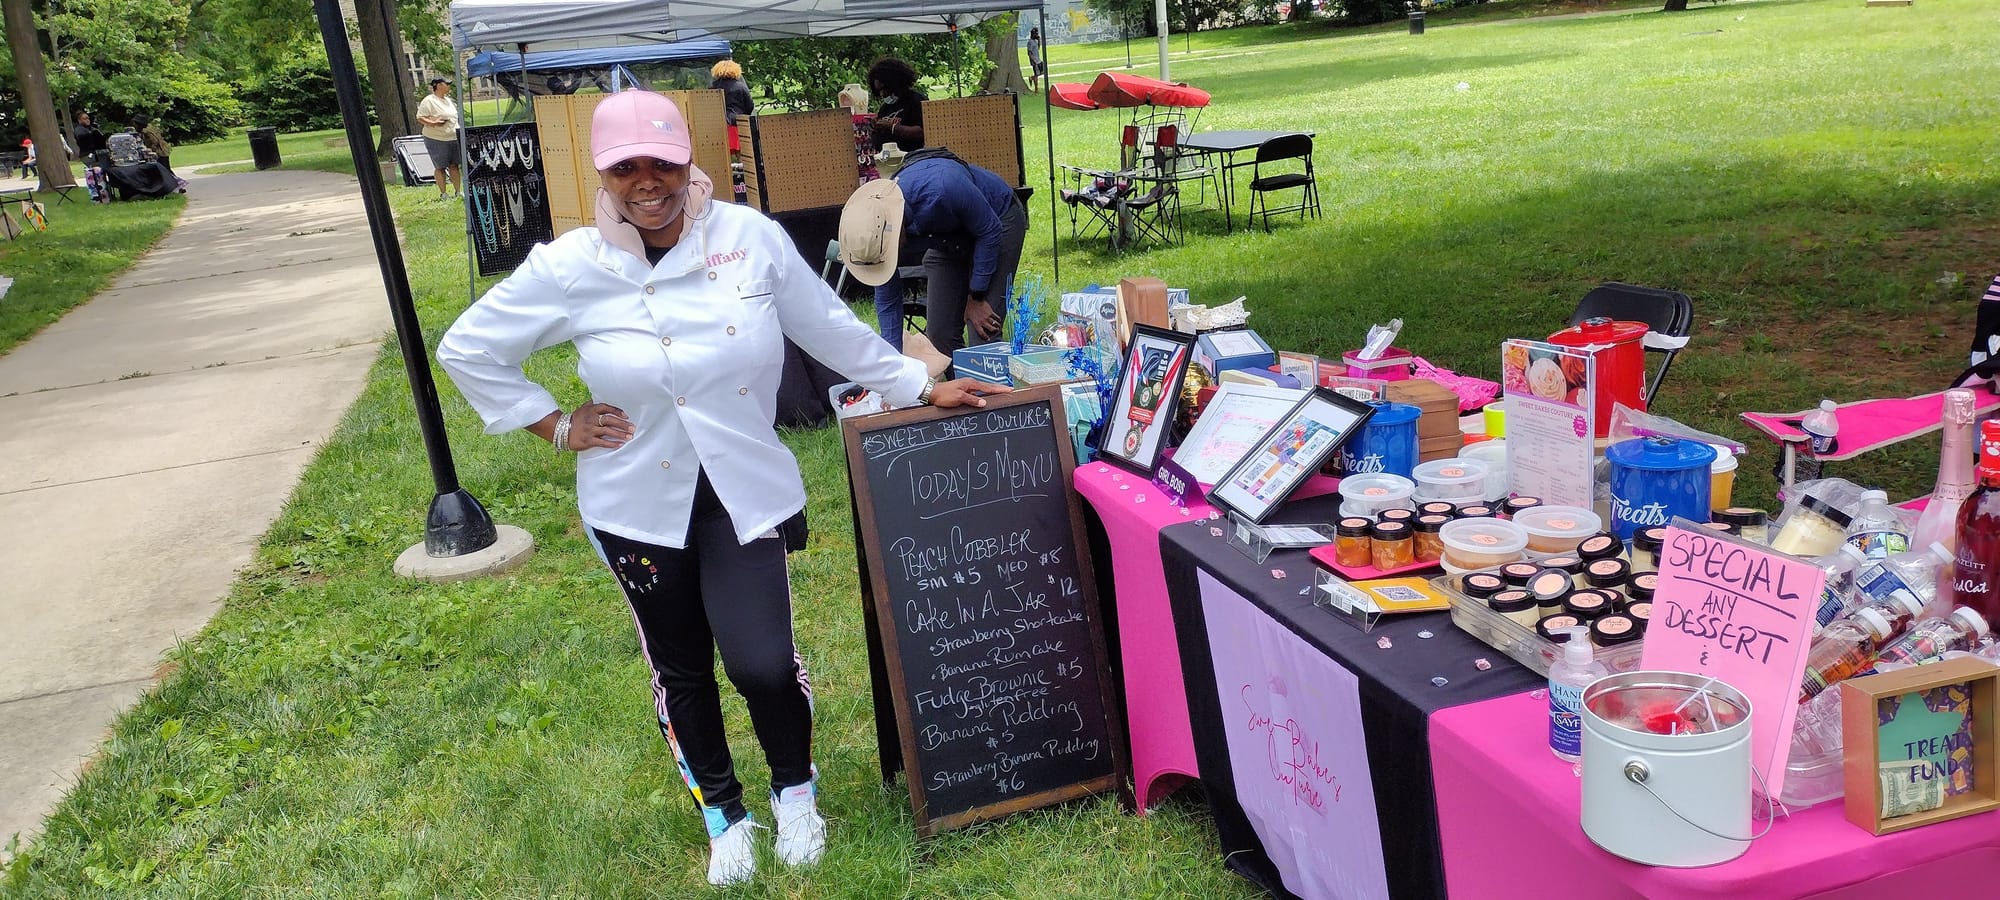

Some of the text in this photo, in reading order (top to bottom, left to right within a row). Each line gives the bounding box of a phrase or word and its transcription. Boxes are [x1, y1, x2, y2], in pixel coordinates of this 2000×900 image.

[706, 248, 748, 268] iffany
[1341, 445, 1385, 473] Treats
[1158, 466, 1185, 495] GIRL BOSS
[1611, 492, 1669, 526] Treats
[1669, 533, 1799, 600] SPECIAL
[982, 589, 999, 620] A
[1701, 590, 1738, 621] ANY
[1665, 601, 1789, 664] DESSERT
[914, 687, 971, 718] Fudge
[1556, 715, 1581, 728] SAYF
[920, 722, 994, 751] Banana
[1904, 733, 1961, 760] TREAT
[1910, 760, 1958, 783] FUND
